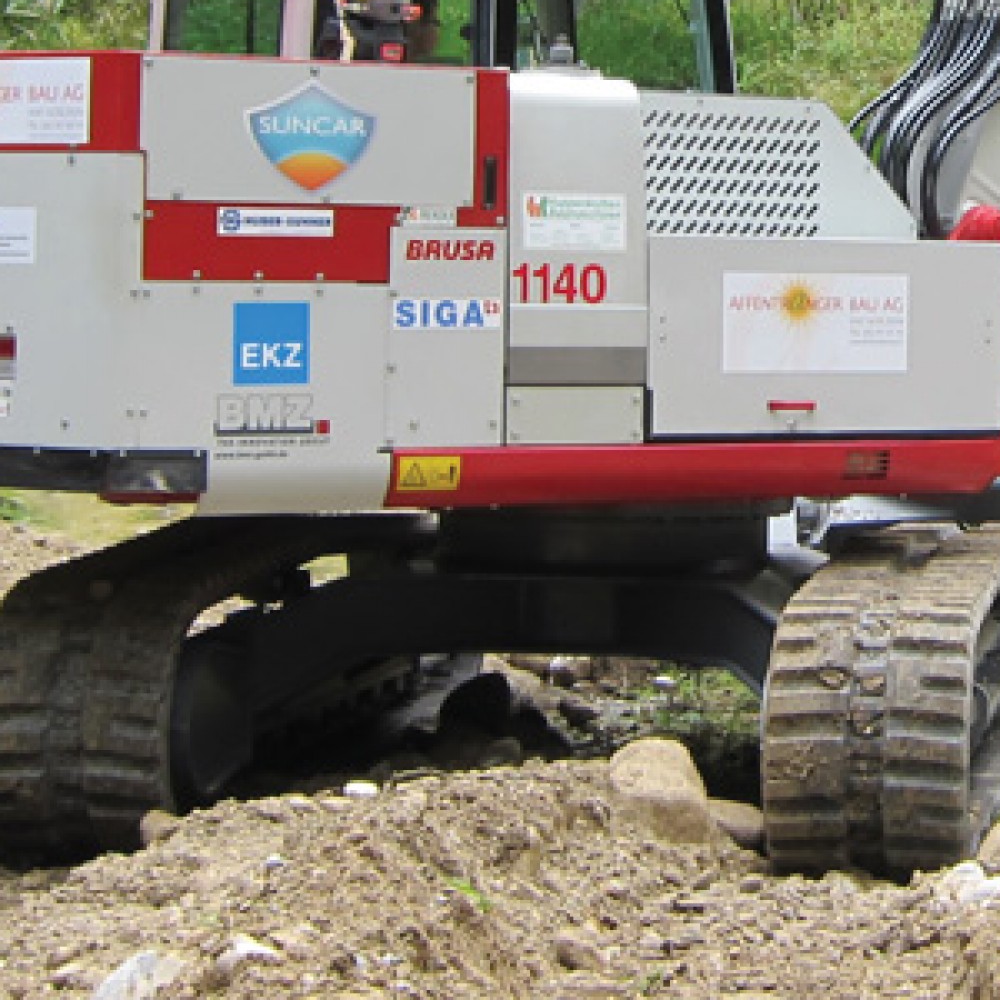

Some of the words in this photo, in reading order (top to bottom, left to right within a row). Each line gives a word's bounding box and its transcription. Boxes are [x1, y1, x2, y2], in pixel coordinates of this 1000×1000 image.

[63, 84, 84, 104] AG
[258, 113, 368, 137] SUNCAR
[405, 239, 495, 261] BRUSA
[512, 262, 608, 304] 1140
[396, 299, 484, 328] SIGA
[240, 341, 304, 370] EKZ
[215, 393, 315, 435] BMZ
